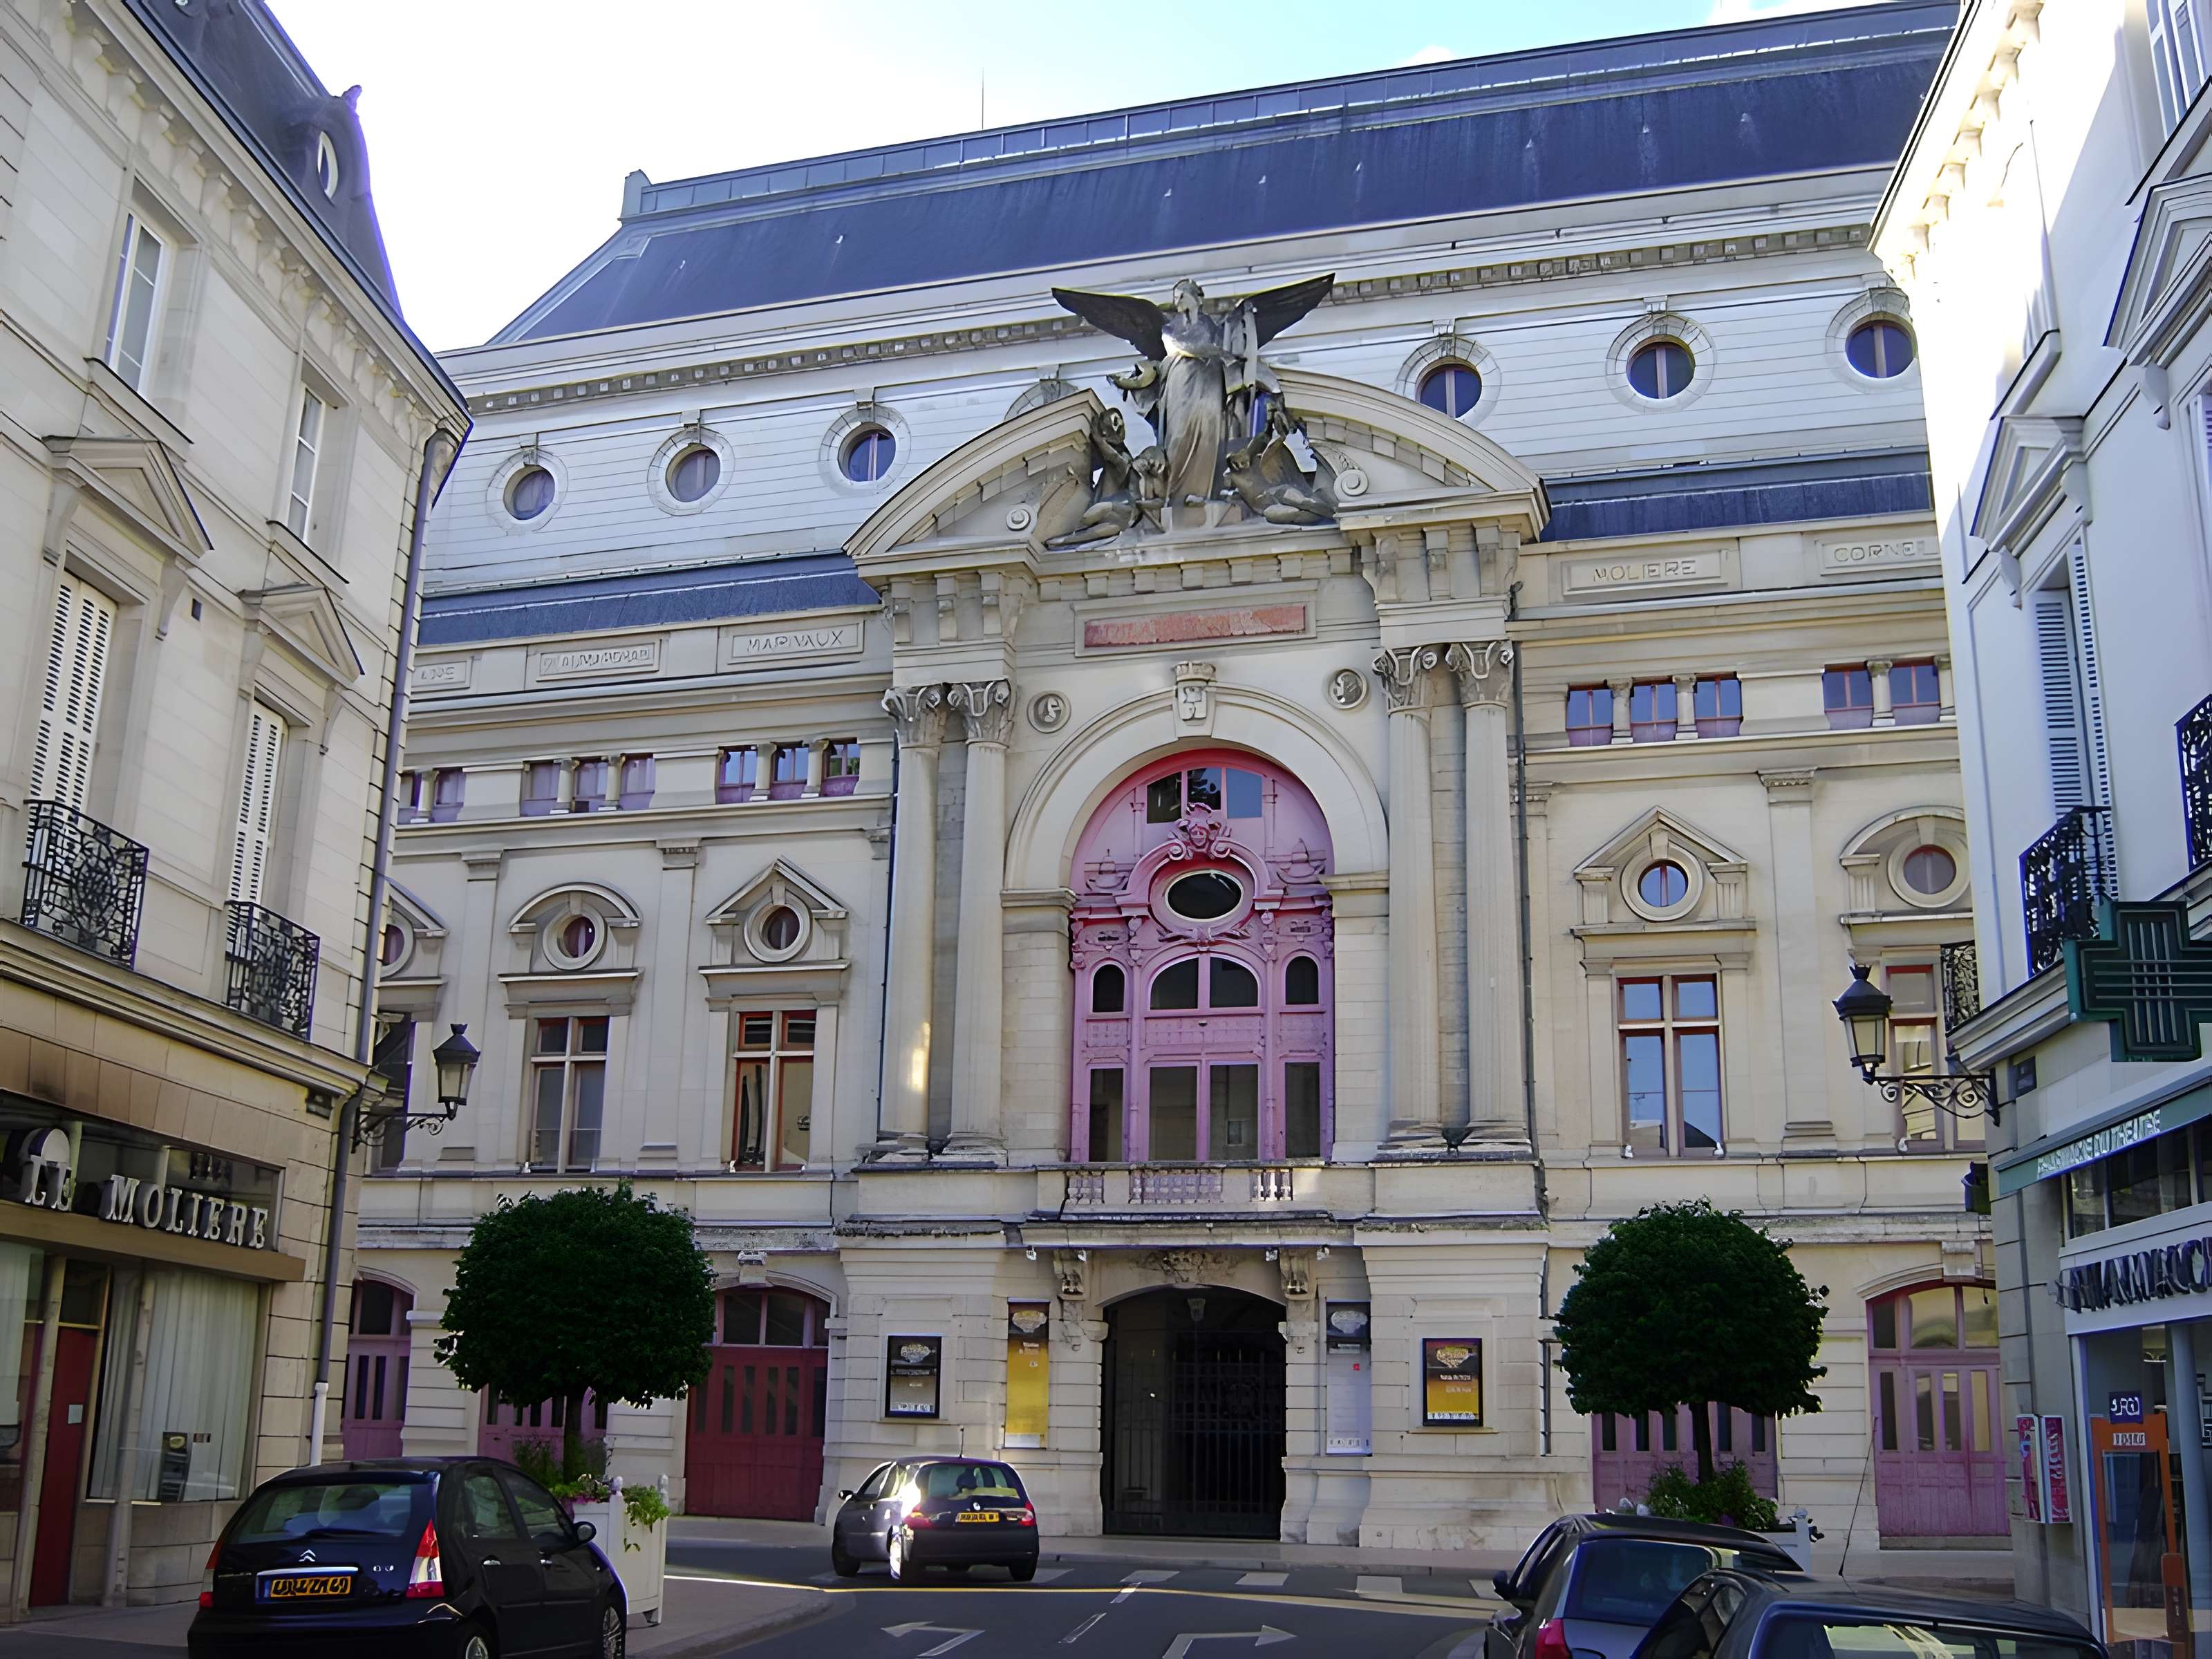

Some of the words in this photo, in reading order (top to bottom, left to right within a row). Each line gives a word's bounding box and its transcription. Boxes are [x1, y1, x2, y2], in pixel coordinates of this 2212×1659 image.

[1593, 560, 1696, 582] MOLIERE
[25, 1154, 73, 1212] LE
[102, 1174, 270, 1250] MOLIERE
